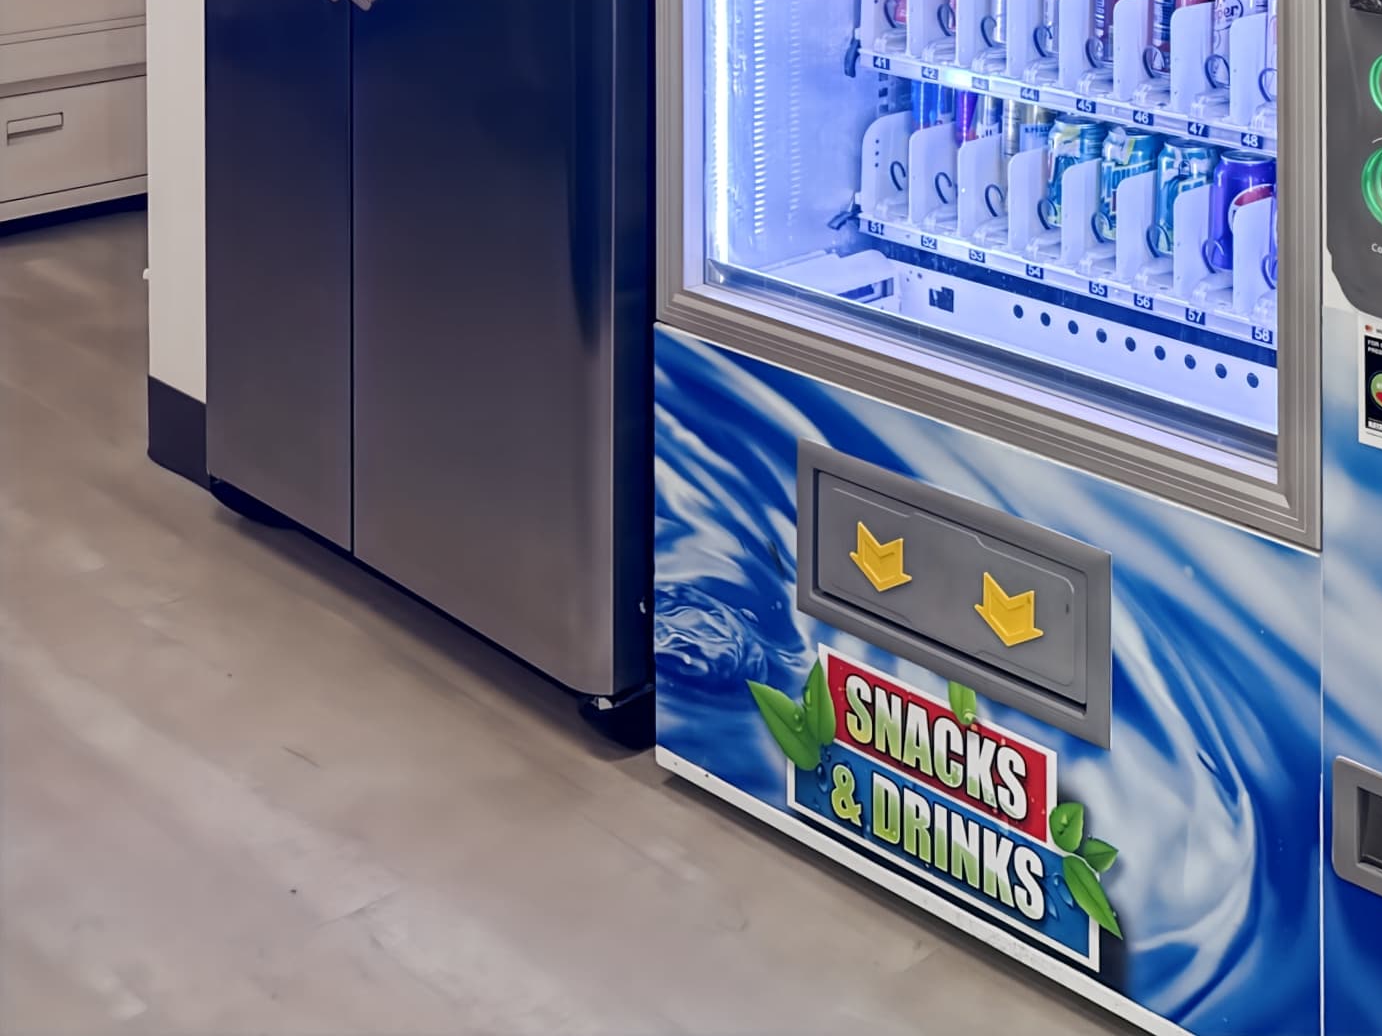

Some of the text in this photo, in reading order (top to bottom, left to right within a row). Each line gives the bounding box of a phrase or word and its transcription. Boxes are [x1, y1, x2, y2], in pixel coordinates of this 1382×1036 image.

[875, 57, 887, 68] 41
[922, 67, 937, 79] 42
[1021, 89, 1036, 100] 44
[1078, 99, 1092, 112] 45
[1135, 112, 1150, 124] 46
[1190, 122, 1205, 136] 47
[1242, 133, 1259, 147] 48
[870, 221, 883, 234] 51
[922, 236, 936, 248] 52
[970, 250, 984, 262] 53
[1028, 265, 1042, 278] 54
[1091, 281, 1105, 295] 55
[1136, 295, 1151, 308] 56
[1187, 309, 1204, 324] 57
[1254, 328, 1271, 343] 58
[845, 674, 1028, 821] SNACKS
[831, 764, 1045, 921] & DRINKS
